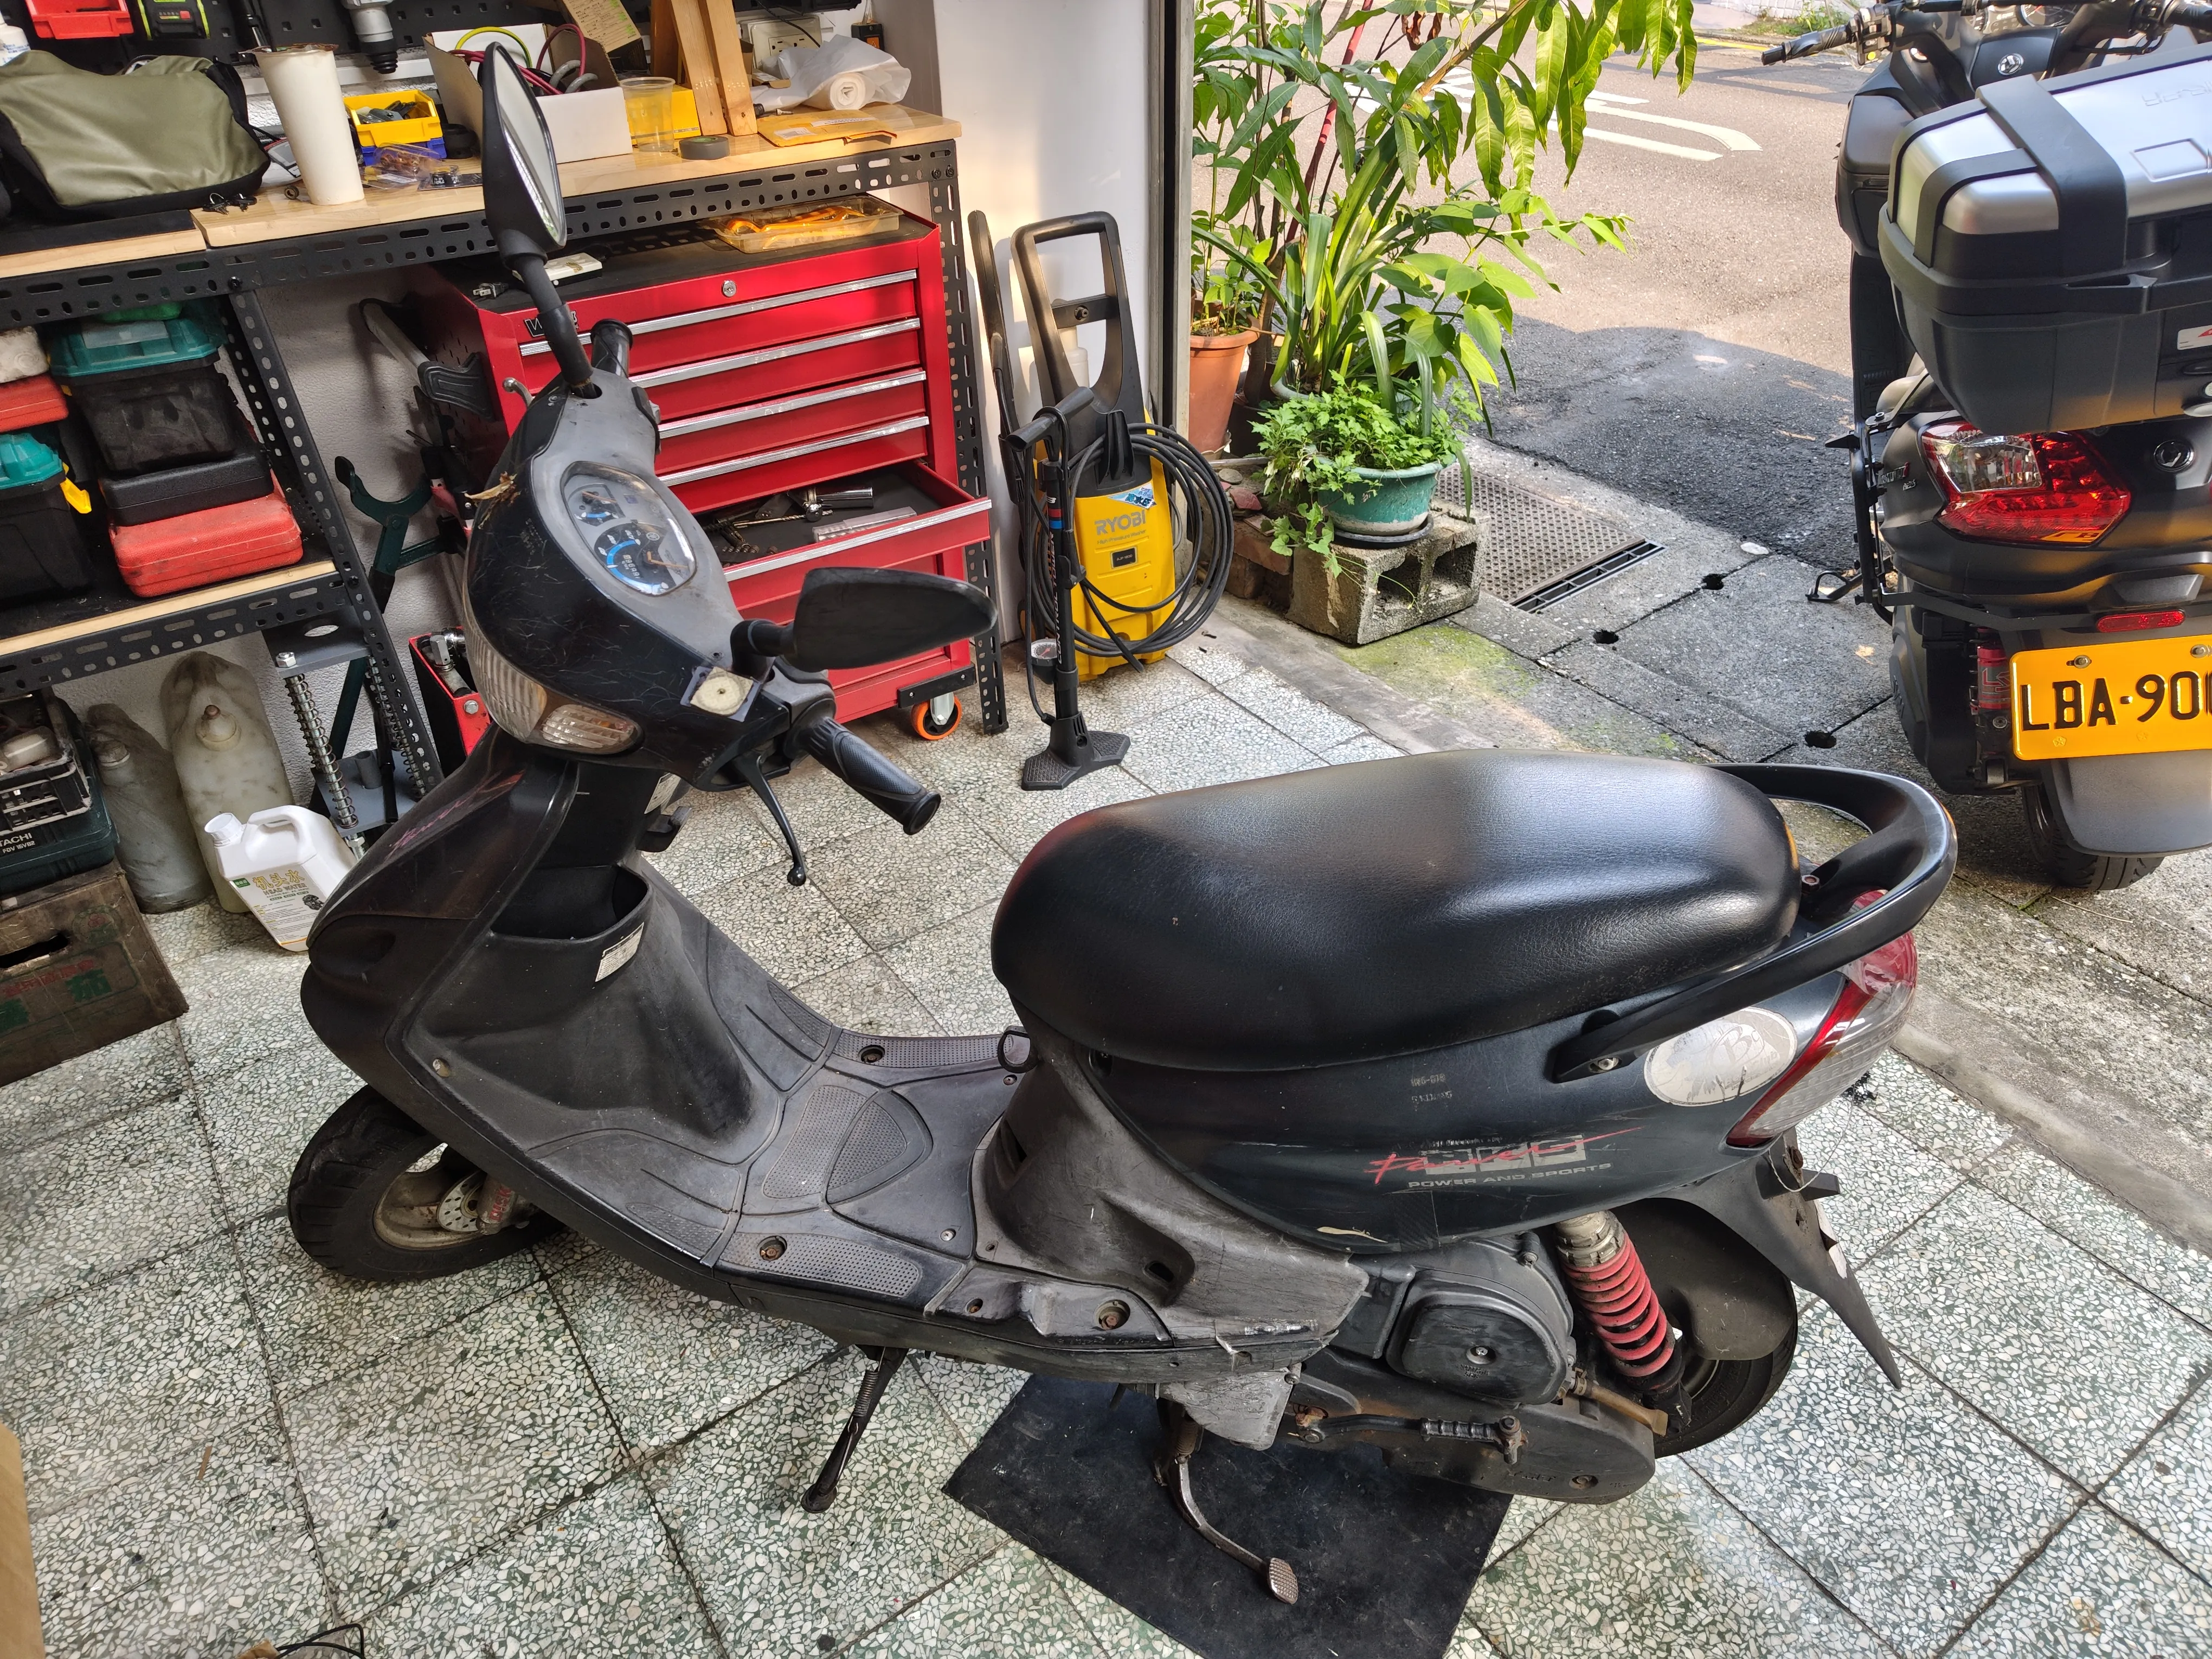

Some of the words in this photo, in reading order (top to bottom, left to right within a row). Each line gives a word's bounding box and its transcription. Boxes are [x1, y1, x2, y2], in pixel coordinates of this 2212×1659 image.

[1094, 509, 1146, 536] RYOBI
[1053, 591, 1062, 664] CONTROL
[2020, 670, 2212, 731] LBA-90
[2, 846, 15, 854] FDV
[16, 840, 36, 850] 16VB2
[252, 869, 305, 890] 机头水
[263, 888, 283, 896] HEAD
[283, 883, 307, 892] WATER
[1408, 1178, 1477, 1188] POWER
[1483, 1173, 1530, 1184] AND
[1532, 1162, 1614, 1180] SPORTS
